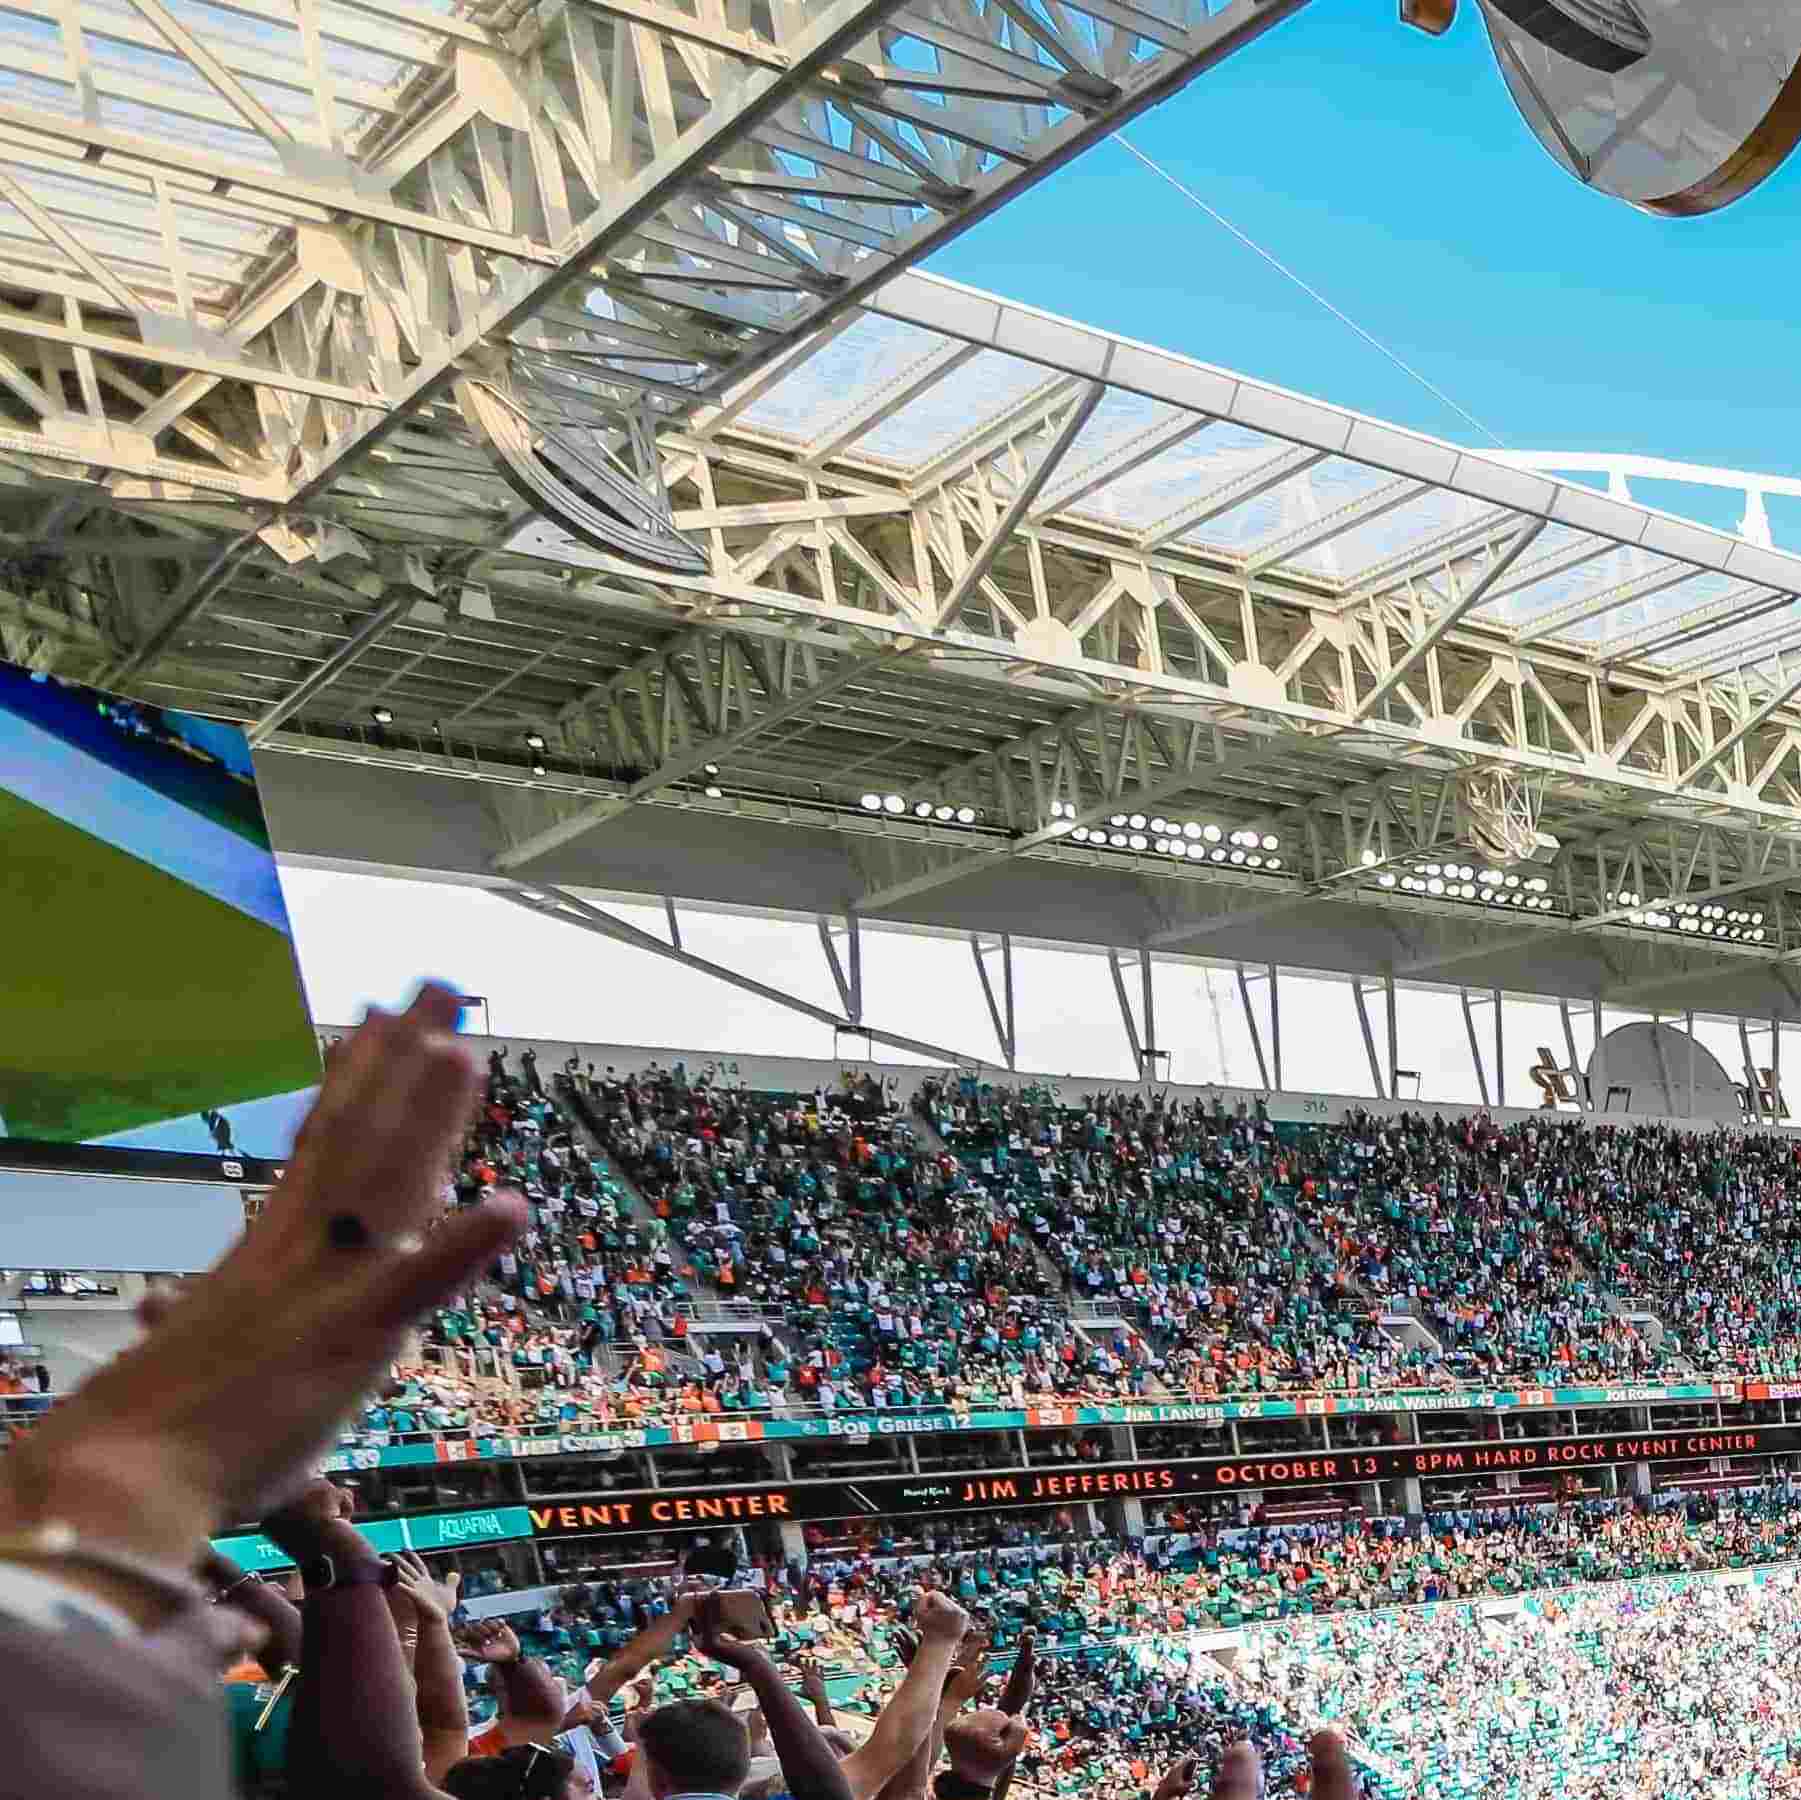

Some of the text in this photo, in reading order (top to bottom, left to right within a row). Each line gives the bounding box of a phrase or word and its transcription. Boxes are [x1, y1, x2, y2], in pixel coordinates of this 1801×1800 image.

[828, 1413, 971, 1436] BOB GRIESE 12
[963, 1433, 1757, 1501] JIM JEFFERIES OCTOBER 13 8PM HARD ROCK EVENT CENTER
[438, 1512, 506, 1541] AQUAFINA
[530, 1493, 791, 1530] VENT CENTER
